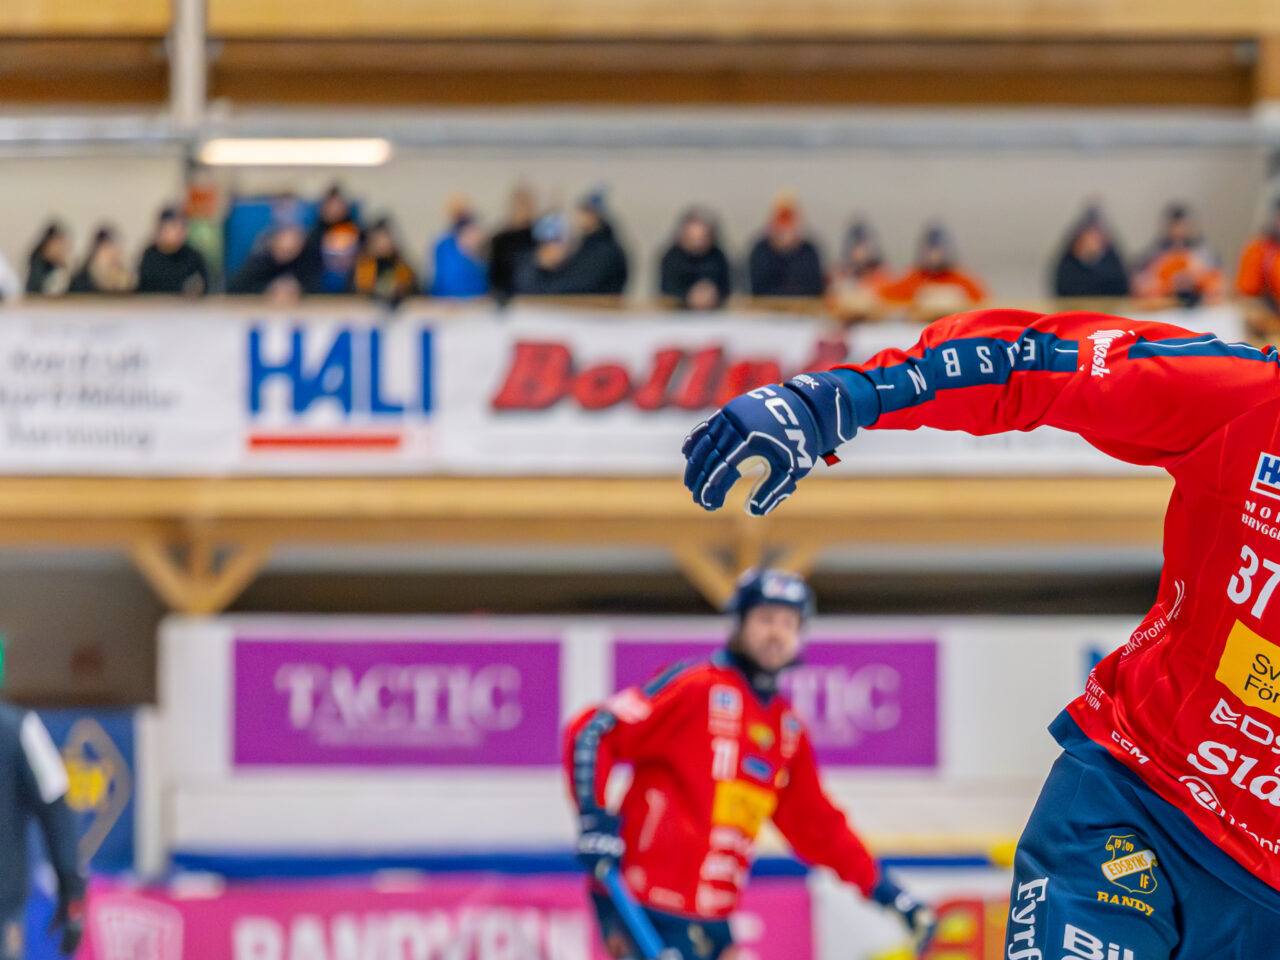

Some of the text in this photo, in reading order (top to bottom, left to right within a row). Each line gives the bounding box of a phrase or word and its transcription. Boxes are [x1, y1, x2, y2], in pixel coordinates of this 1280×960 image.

[247, 321, 434, 417] HALI
[746, 386, 813, 468] CCM
[275, 662, 522, 733] TACTIC
[1111, 730, 1151, 765] CCM
[1106, 853, 1149, 877] EDSBYNS
[1139, 873, 1150, 889] IF
[1097, 891, 1155, 917] BANDY
